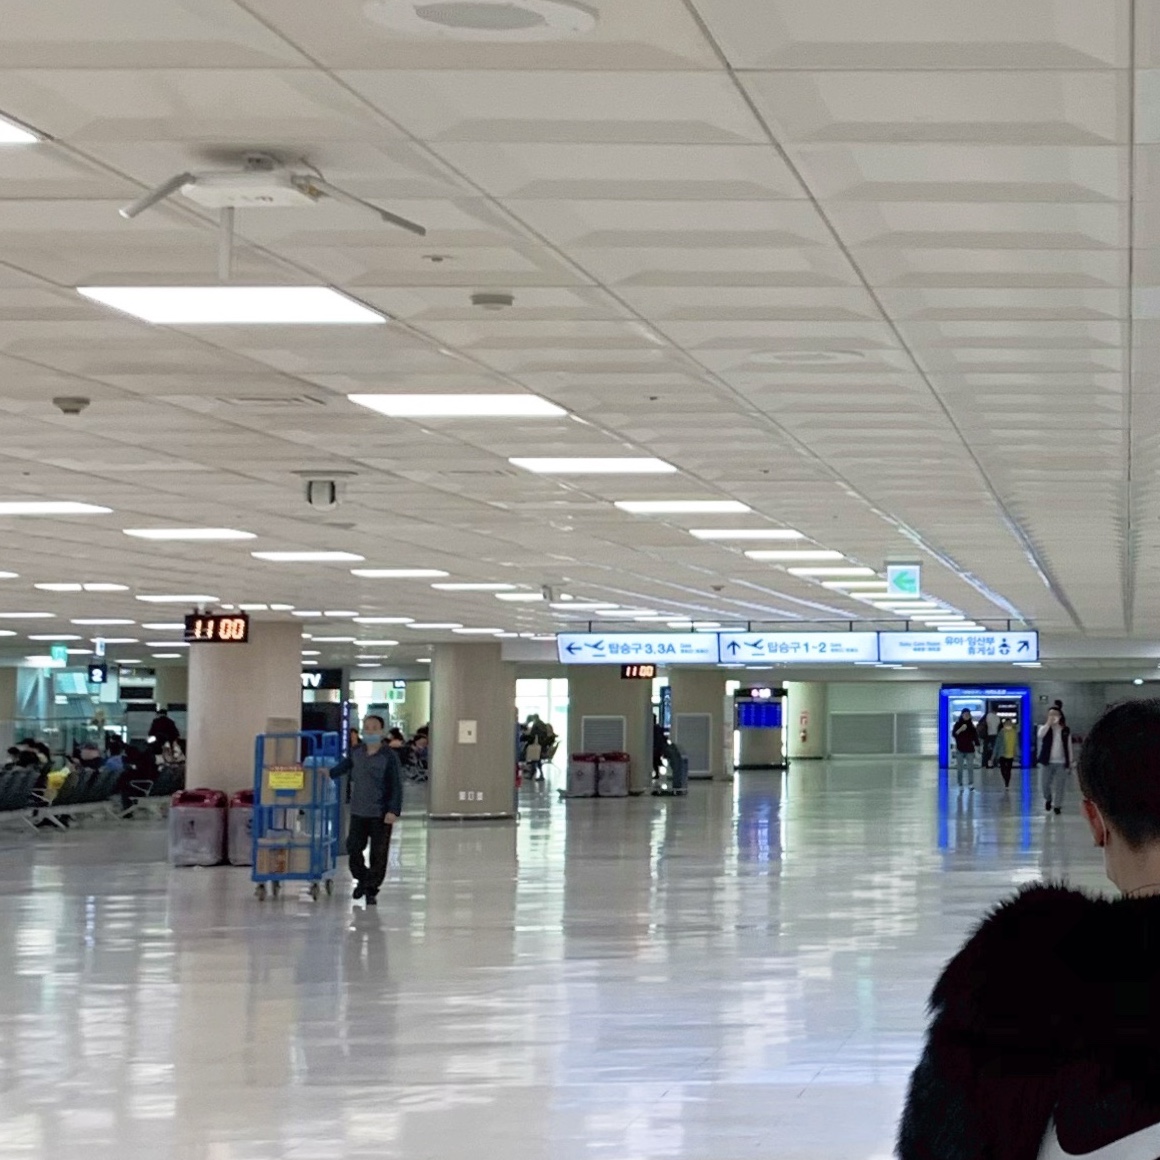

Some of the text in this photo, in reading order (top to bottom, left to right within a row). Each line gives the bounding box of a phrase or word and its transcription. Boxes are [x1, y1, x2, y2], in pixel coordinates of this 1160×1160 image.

[608, 643, 642, 654] 탑승구
[767, 642, 801, 653] 탑승구
[92, 668, 103, 682] 2
[300, 673, 322, 687] TV
